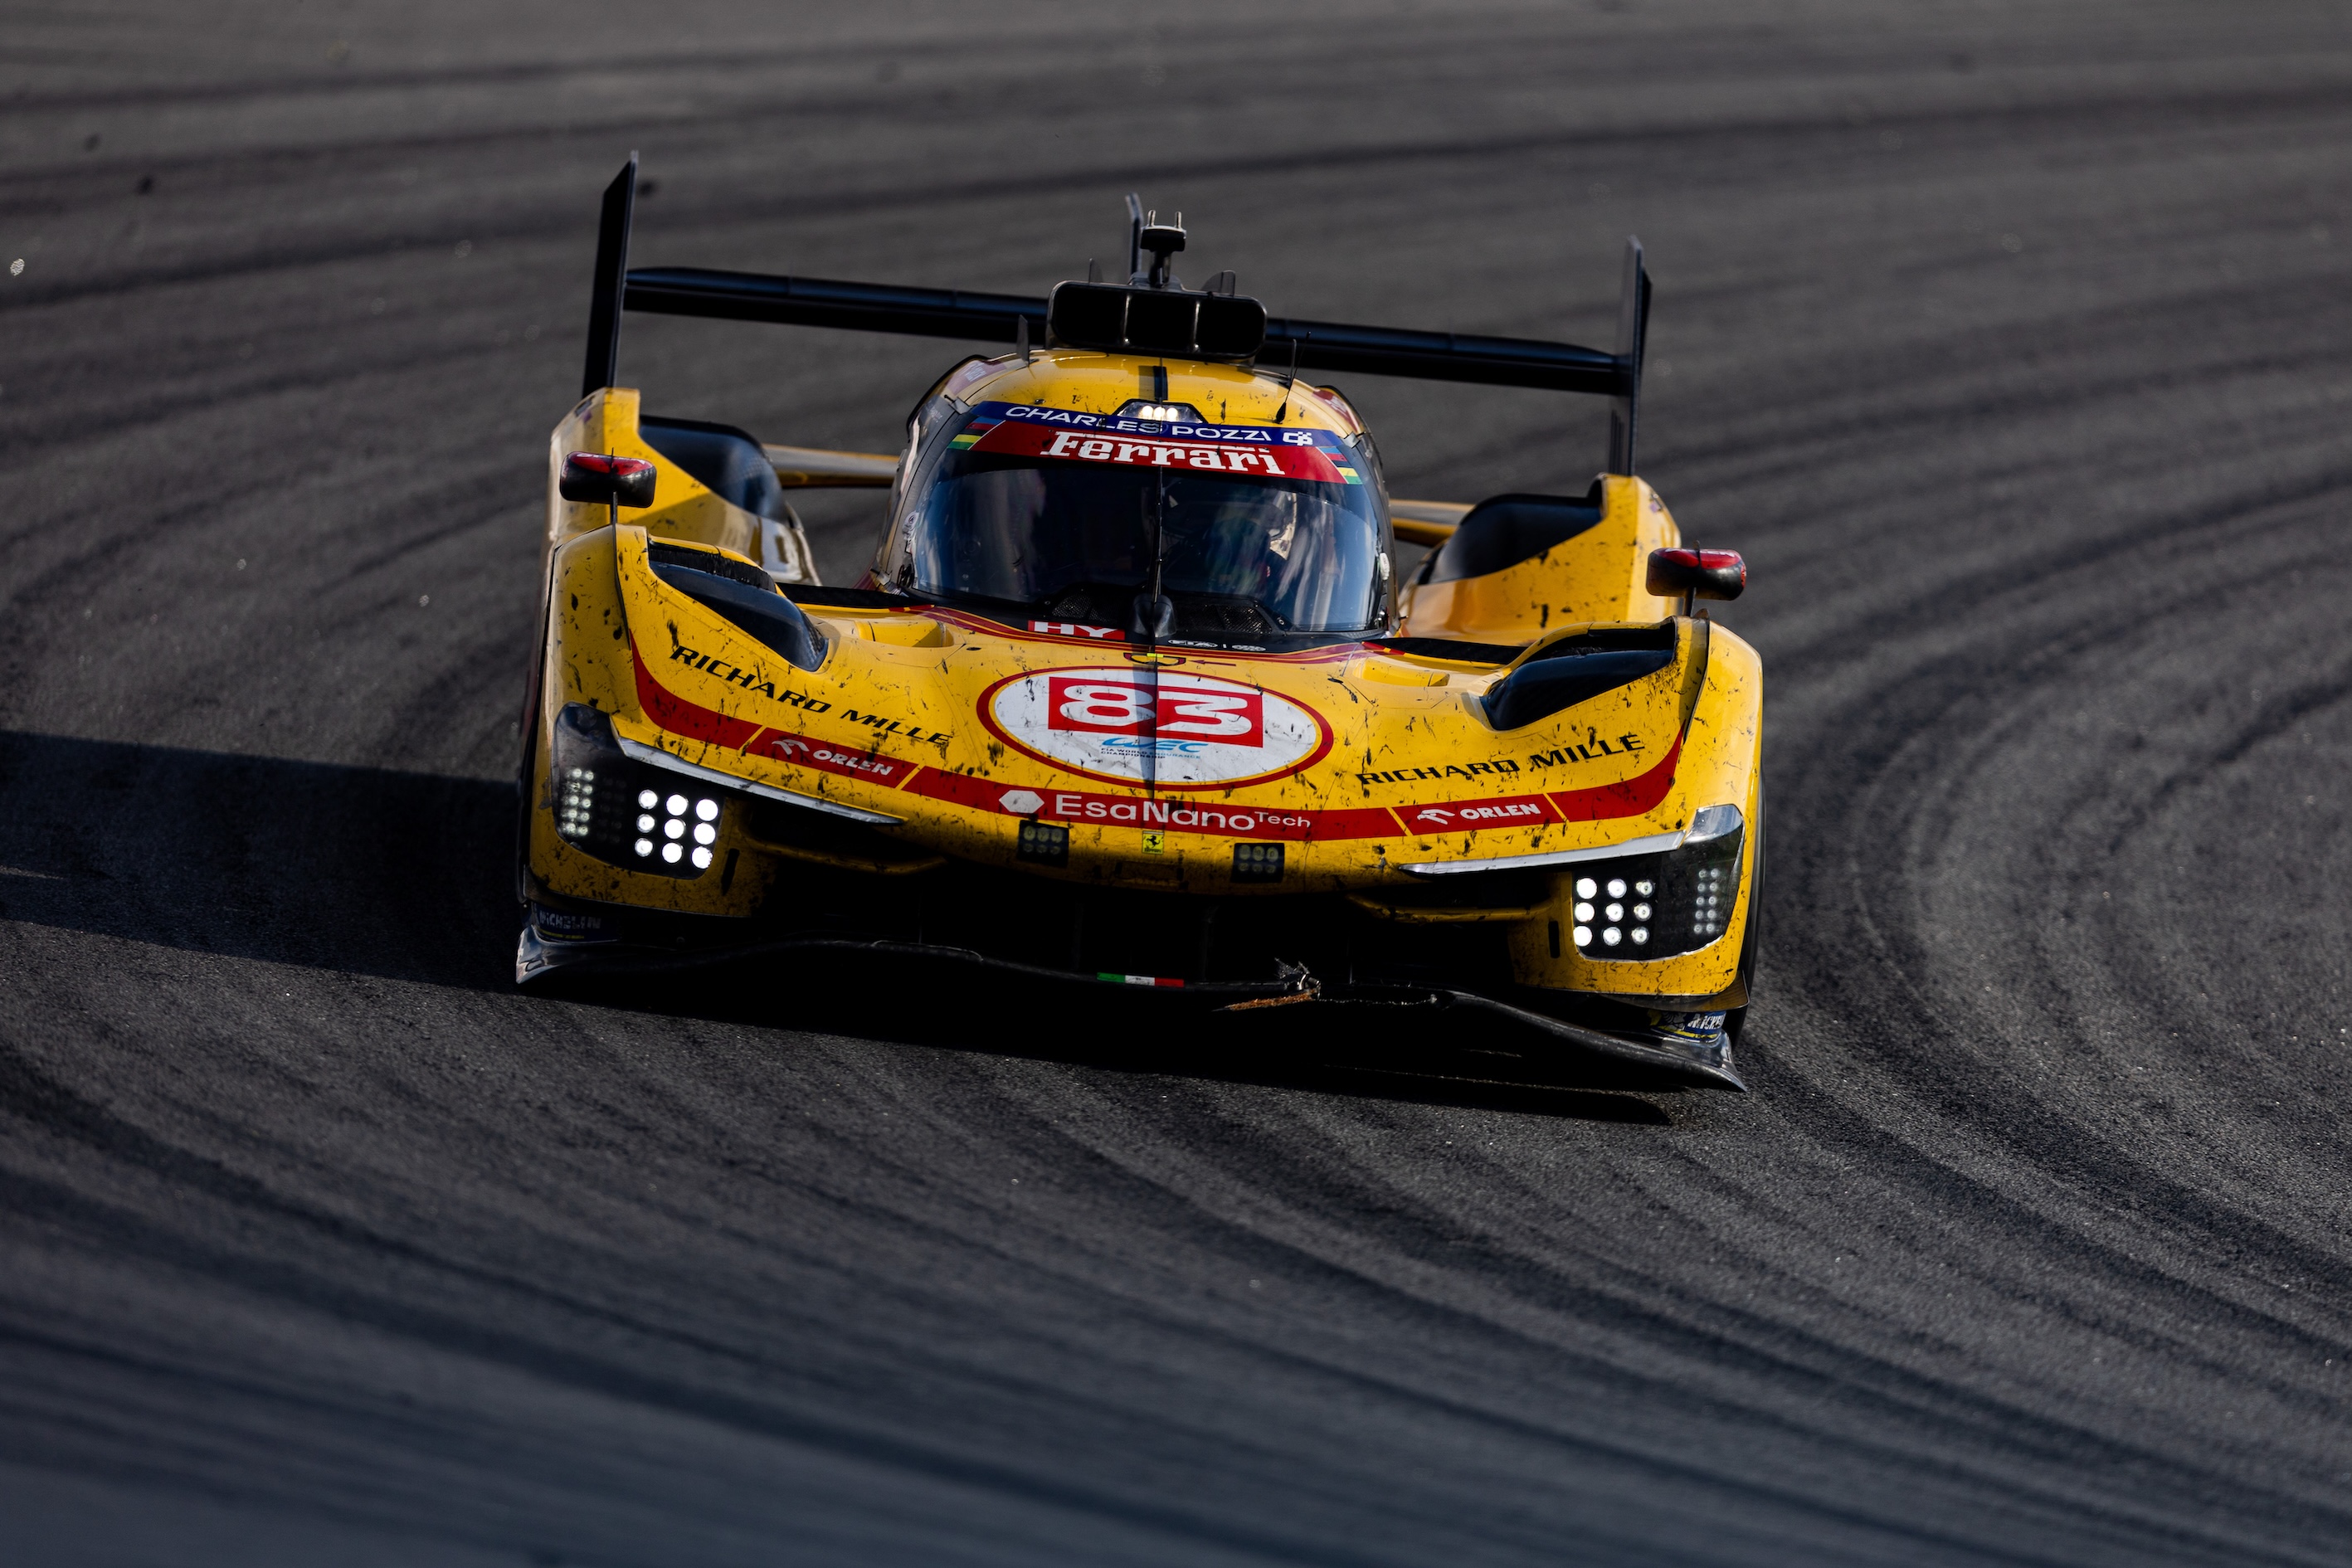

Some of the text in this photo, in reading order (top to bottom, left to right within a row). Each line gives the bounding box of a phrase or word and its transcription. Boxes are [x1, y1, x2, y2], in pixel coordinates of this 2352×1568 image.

[1005, 406, 1162, 435] CHARLES
[1171, 425, 1272, 442] POZZI
[1040, 431, 1286, 475] Ferrari
[1034, 621, 1118, 638] HY
[670, 645, 953, 747] RICHARD MILLE
[1059, 684, 1252, 736] 83
[1101, 751, 1166, 759] CHAMPIONSHIP
[1102, 738, 1208, 752] WEC
[813, 748, 894, 776] ORLEN
[1356, 734, 1646, 785] RICHARD MILLE
[1459, 803, 1541, 821] ORLEN
[539, 910, 601, 929] MICHELIN
